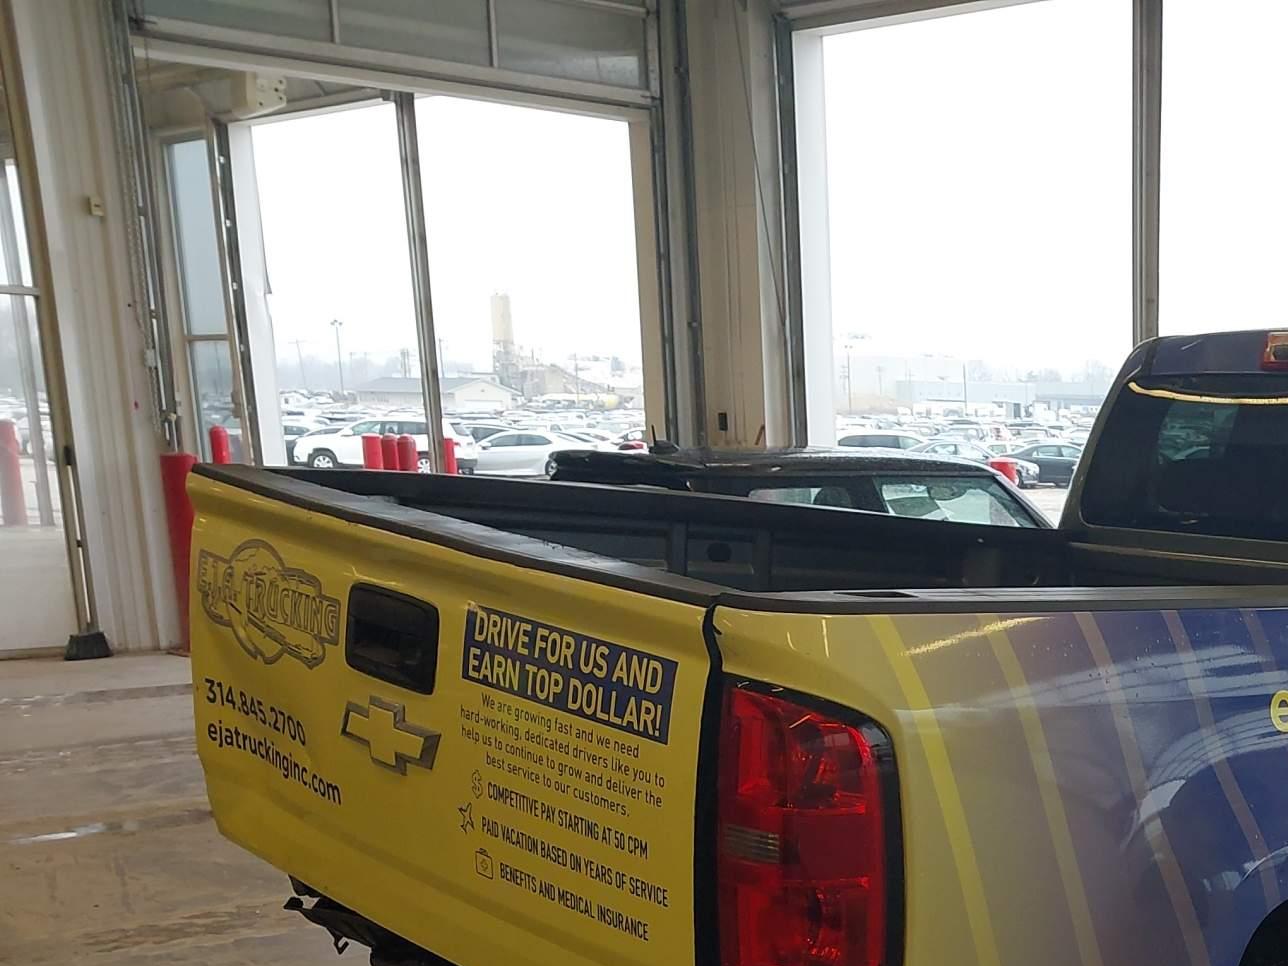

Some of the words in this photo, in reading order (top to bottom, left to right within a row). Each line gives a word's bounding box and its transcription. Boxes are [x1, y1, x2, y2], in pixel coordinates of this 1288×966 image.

[243, 573, 338, 638] TRUCKING
[468, 647, 520, 691] EARN
[525, 664, 563, 703] TOP
[568, 678, 662, 737] DOLLAR!
[474, 611, 532, 655] DRIVE
[534, 628, 575, 669] FOR
[579, 641, 610, 678] US
[612, 652, 663, 694] AND
[205, 678, 306, 746] 314.845.2700
[460, 704, 522, 741] hard-working,
[525, 728, 569, 755] dedicated
[572, 744, 608, 768] drivers
[611, 756, 630, 776] like
[632, 767, 651, 784] you
[655, 772, 665, 788] to
[481, 692, 495, 709] We
[497, 702, 512, 715] are
[515, 708, 551, 732] growing
[554, 717, 572, 736] fast
[575, 727, 593, 743] and
[596, 734, 610, 748] we
[613, 740, 640, 758] need
[207, 720, 341, 805] ejatruckinginc.com
[461, 725, 480, 744] help
[482, 735, 492, 746] us
[495, 737, 503, 751] to
[505, 743, 543, 766] continue
[546, 755, 555, 770] to
[558, 762, 582, 779] grow
[585, 771, 603, 787] and
[606, 777, 642, 800] deliver
[645, 790, 662, 808] the
[486, 752, 505, 770] best
[507, 763, 540, 784] service
[543, 774, 551, 788] to
[554, 781, 570, 796] our
[573, 787, 630, 817] customers.
[487, 782, 539, 818] COMPETITIVE
[540, 802, 556, 824] PAY
[558, 810, 599, 841] STARTING
[601, 827, 613, 846] AT
[614, 831, 625, 851] 50
[627, 837, 648, 860] CPM
[482, 816, 499, 838] PAID
[500, 823, 538, 856] VACATION
[541, 842, 567, 867] BASED
[570, 853, 581, 873] ON
[583, 857, 612, 886] YEARS
[615, 871, 626, 891] OF
[629, 876, 669, 908] SERVICE
[500, 862, 537, 893] BENEFITS
[539, 880, 556, 901] AND
[557, 887, 595, 919] MEDICAL
[597, 903, 649, 941] INSURANCE
